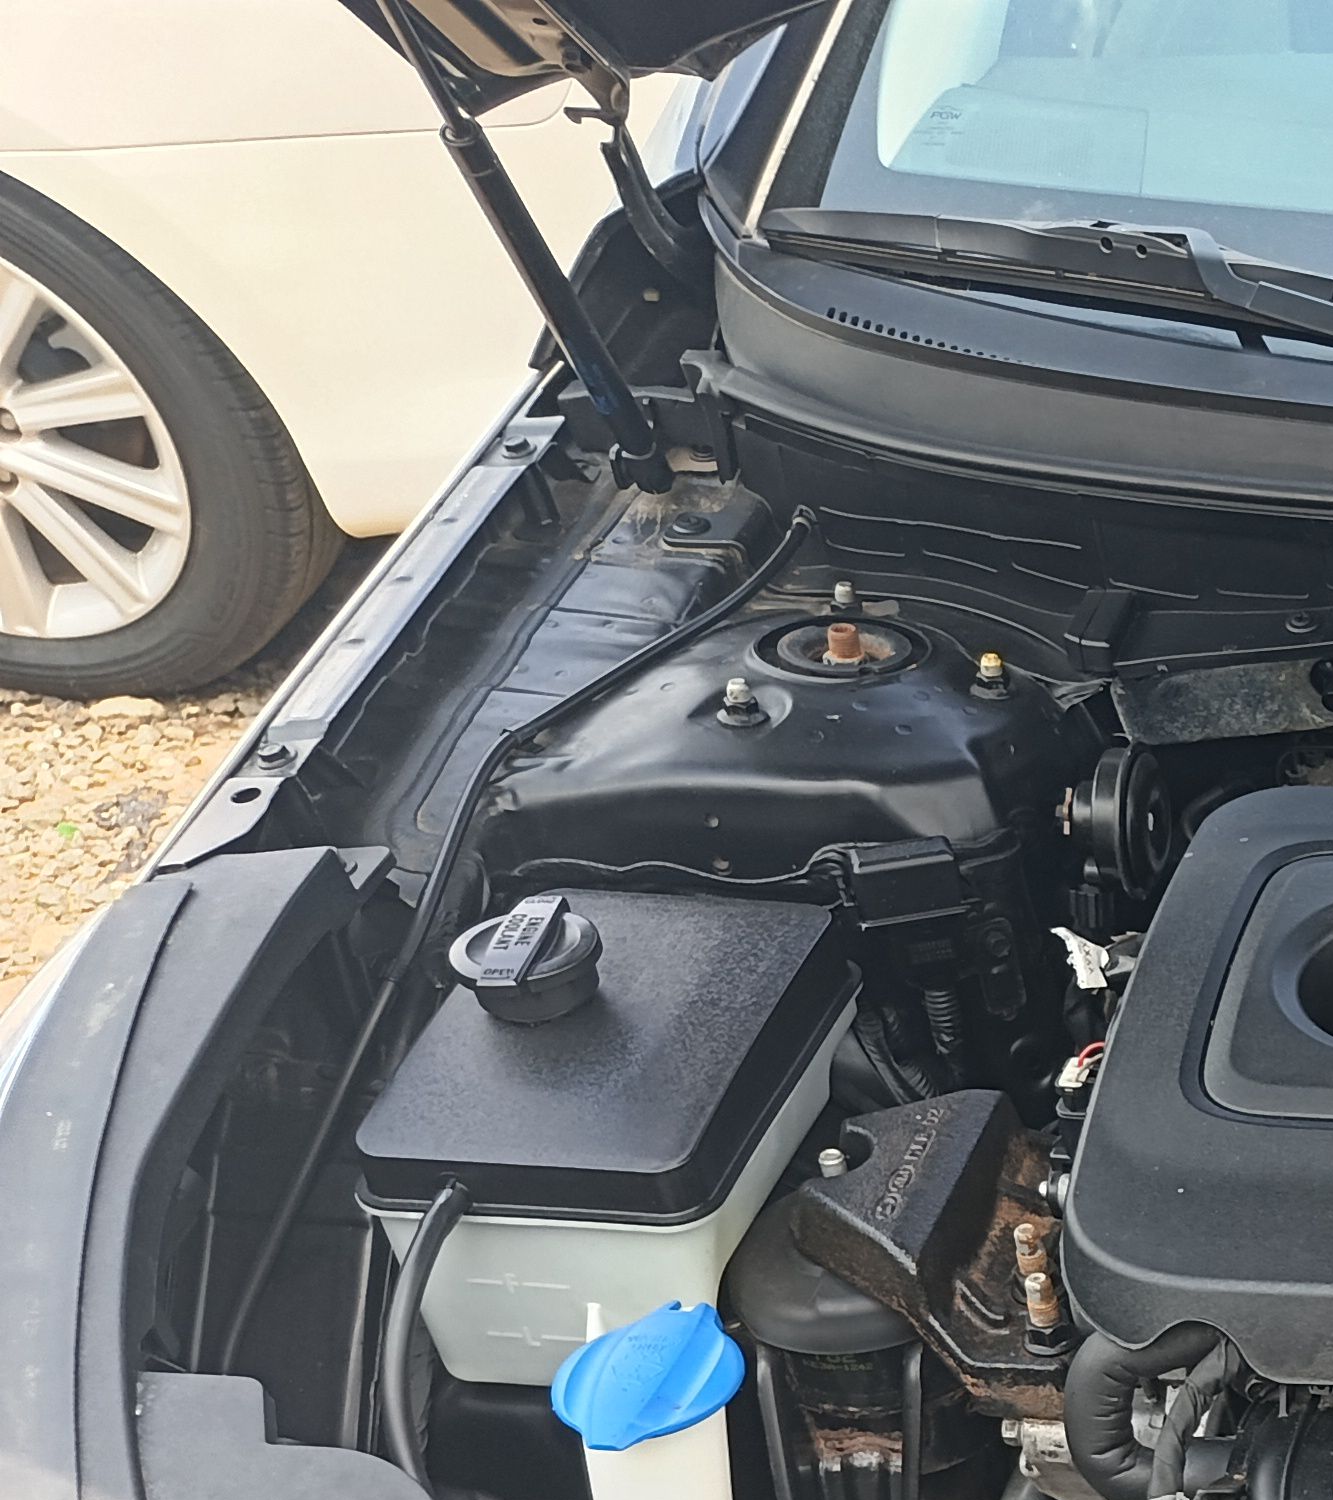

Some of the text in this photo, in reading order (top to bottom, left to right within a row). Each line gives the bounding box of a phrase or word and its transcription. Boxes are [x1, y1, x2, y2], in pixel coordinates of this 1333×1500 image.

[493, 913, 528, 951] COOLANT
[514, 916, 545, 947] ENGINE
[483, 967, 514, 976] OPEN
